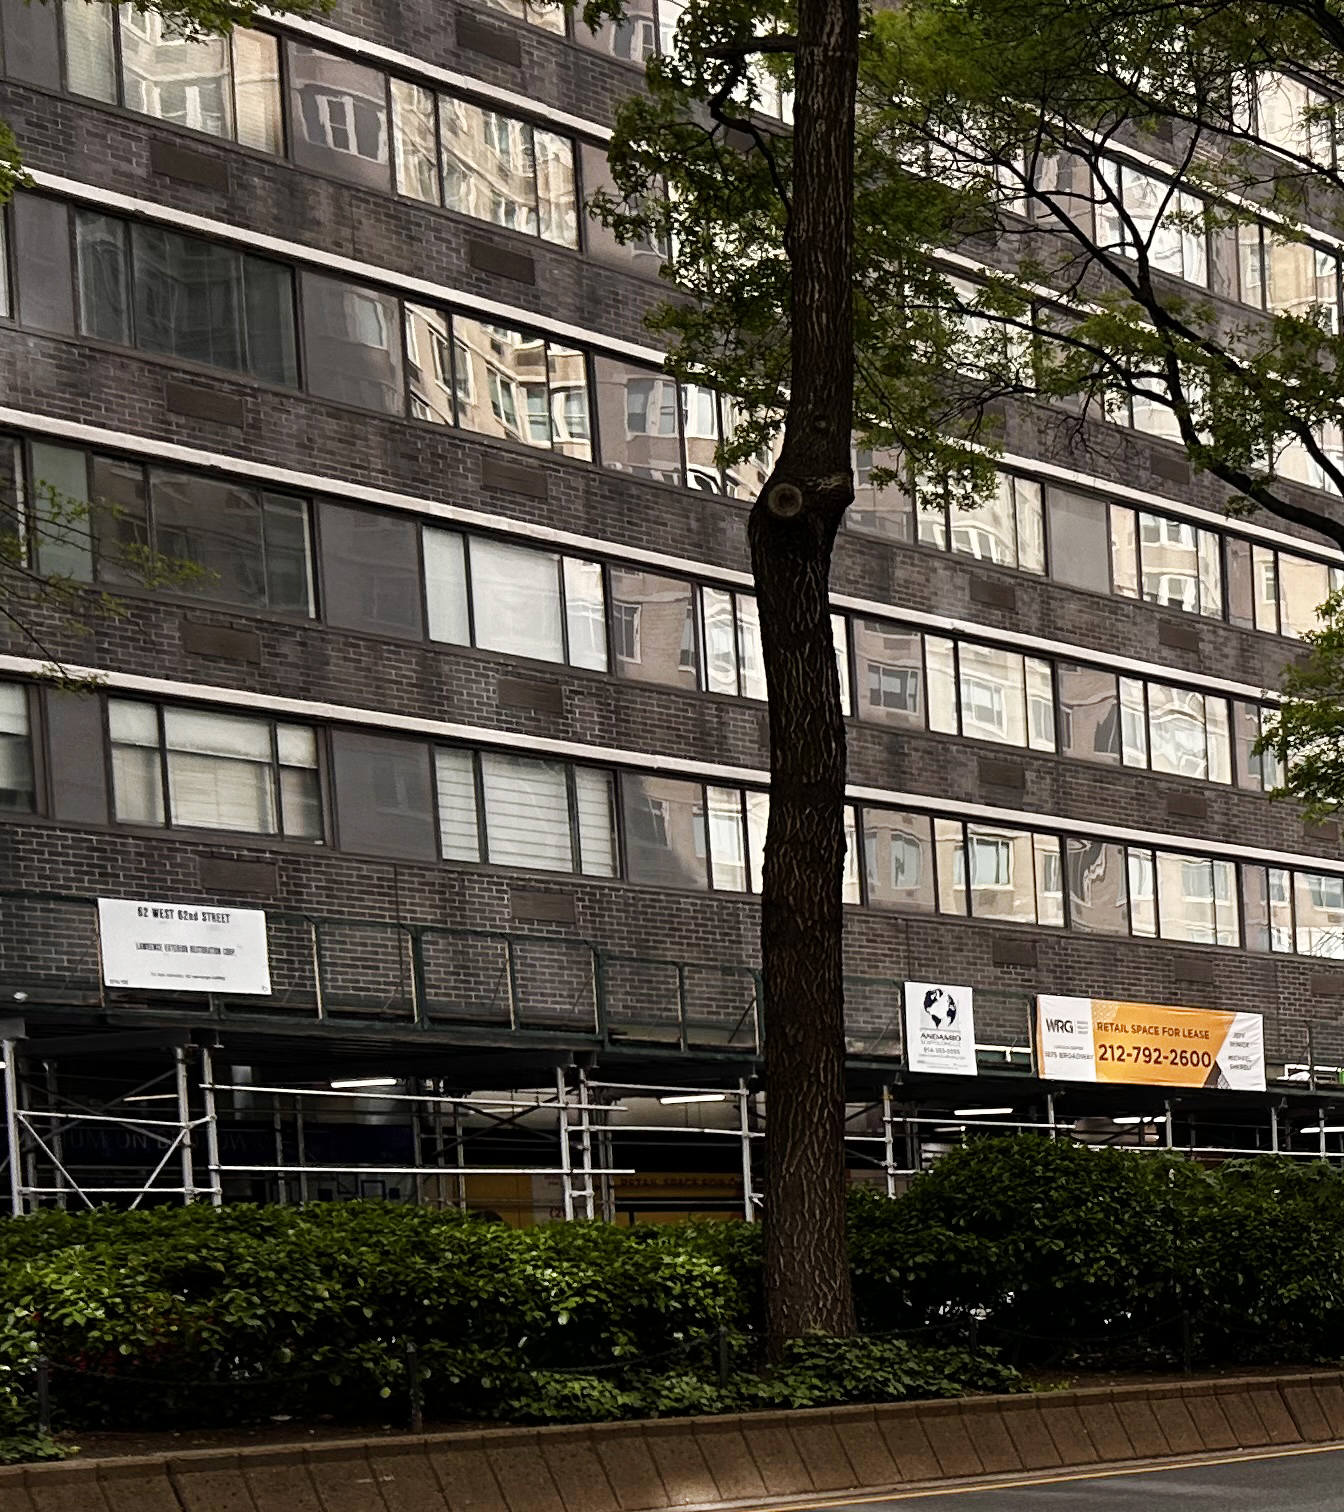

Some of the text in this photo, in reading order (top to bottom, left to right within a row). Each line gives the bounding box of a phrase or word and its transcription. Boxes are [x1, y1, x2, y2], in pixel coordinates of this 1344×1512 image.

[152, 907, 174, 920] WEST
[201, 911, 231, 924] STREET
[1045, 1018, 1074, 1035] WRG
[1096, 1022, 1129, 1034] RETAIL
[1131, 1024, 1160, 1036] SPACE
[1162, 1026, 1181, 1038] FOR
[1182, 1028, 1210, 1040] LEASE
[1098, 1044, 1212, 1068] 212-792-2600
